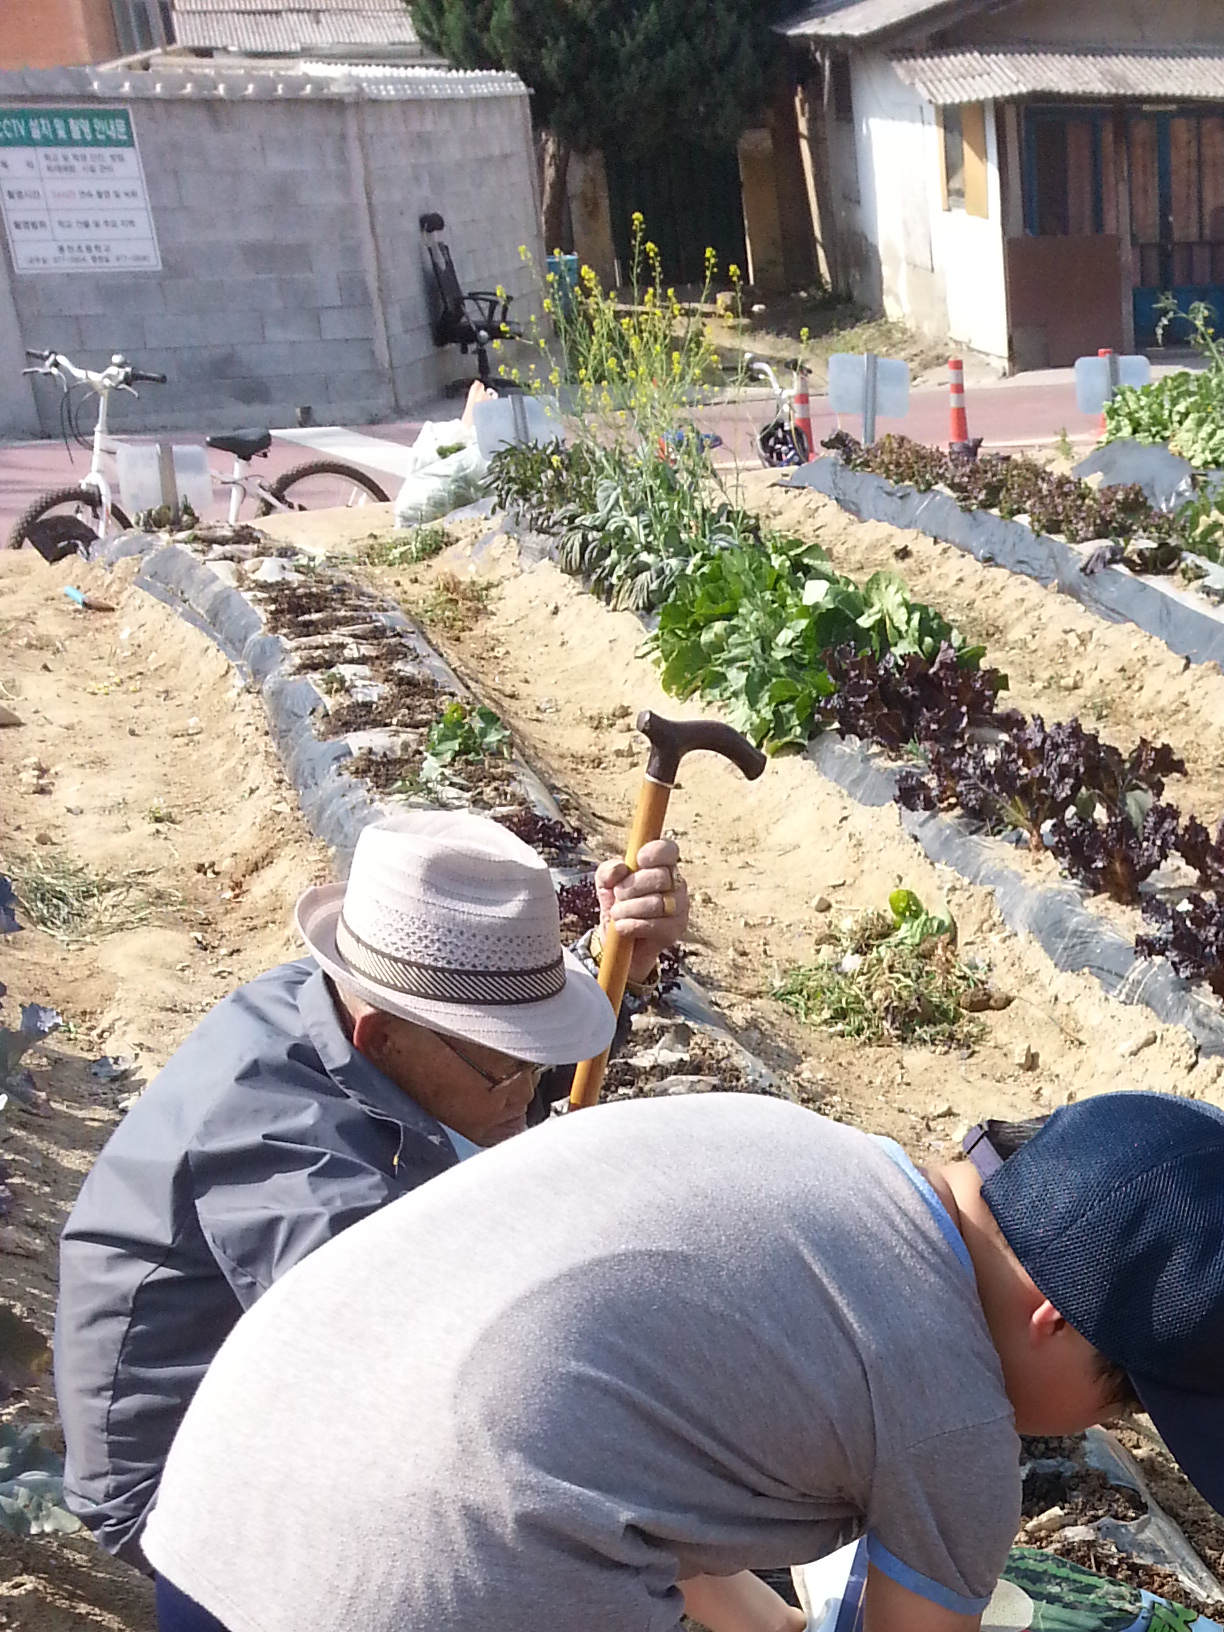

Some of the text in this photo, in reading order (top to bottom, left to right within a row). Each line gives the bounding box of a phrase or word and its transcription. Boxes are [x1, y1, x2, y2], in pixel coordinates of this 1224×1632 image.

[29, 118, 53, 140] 설치
[54, 118, 67, 139] 및
[68, 118, 91, 141] 촬영
[93, 118, 128, 140] 안내문
